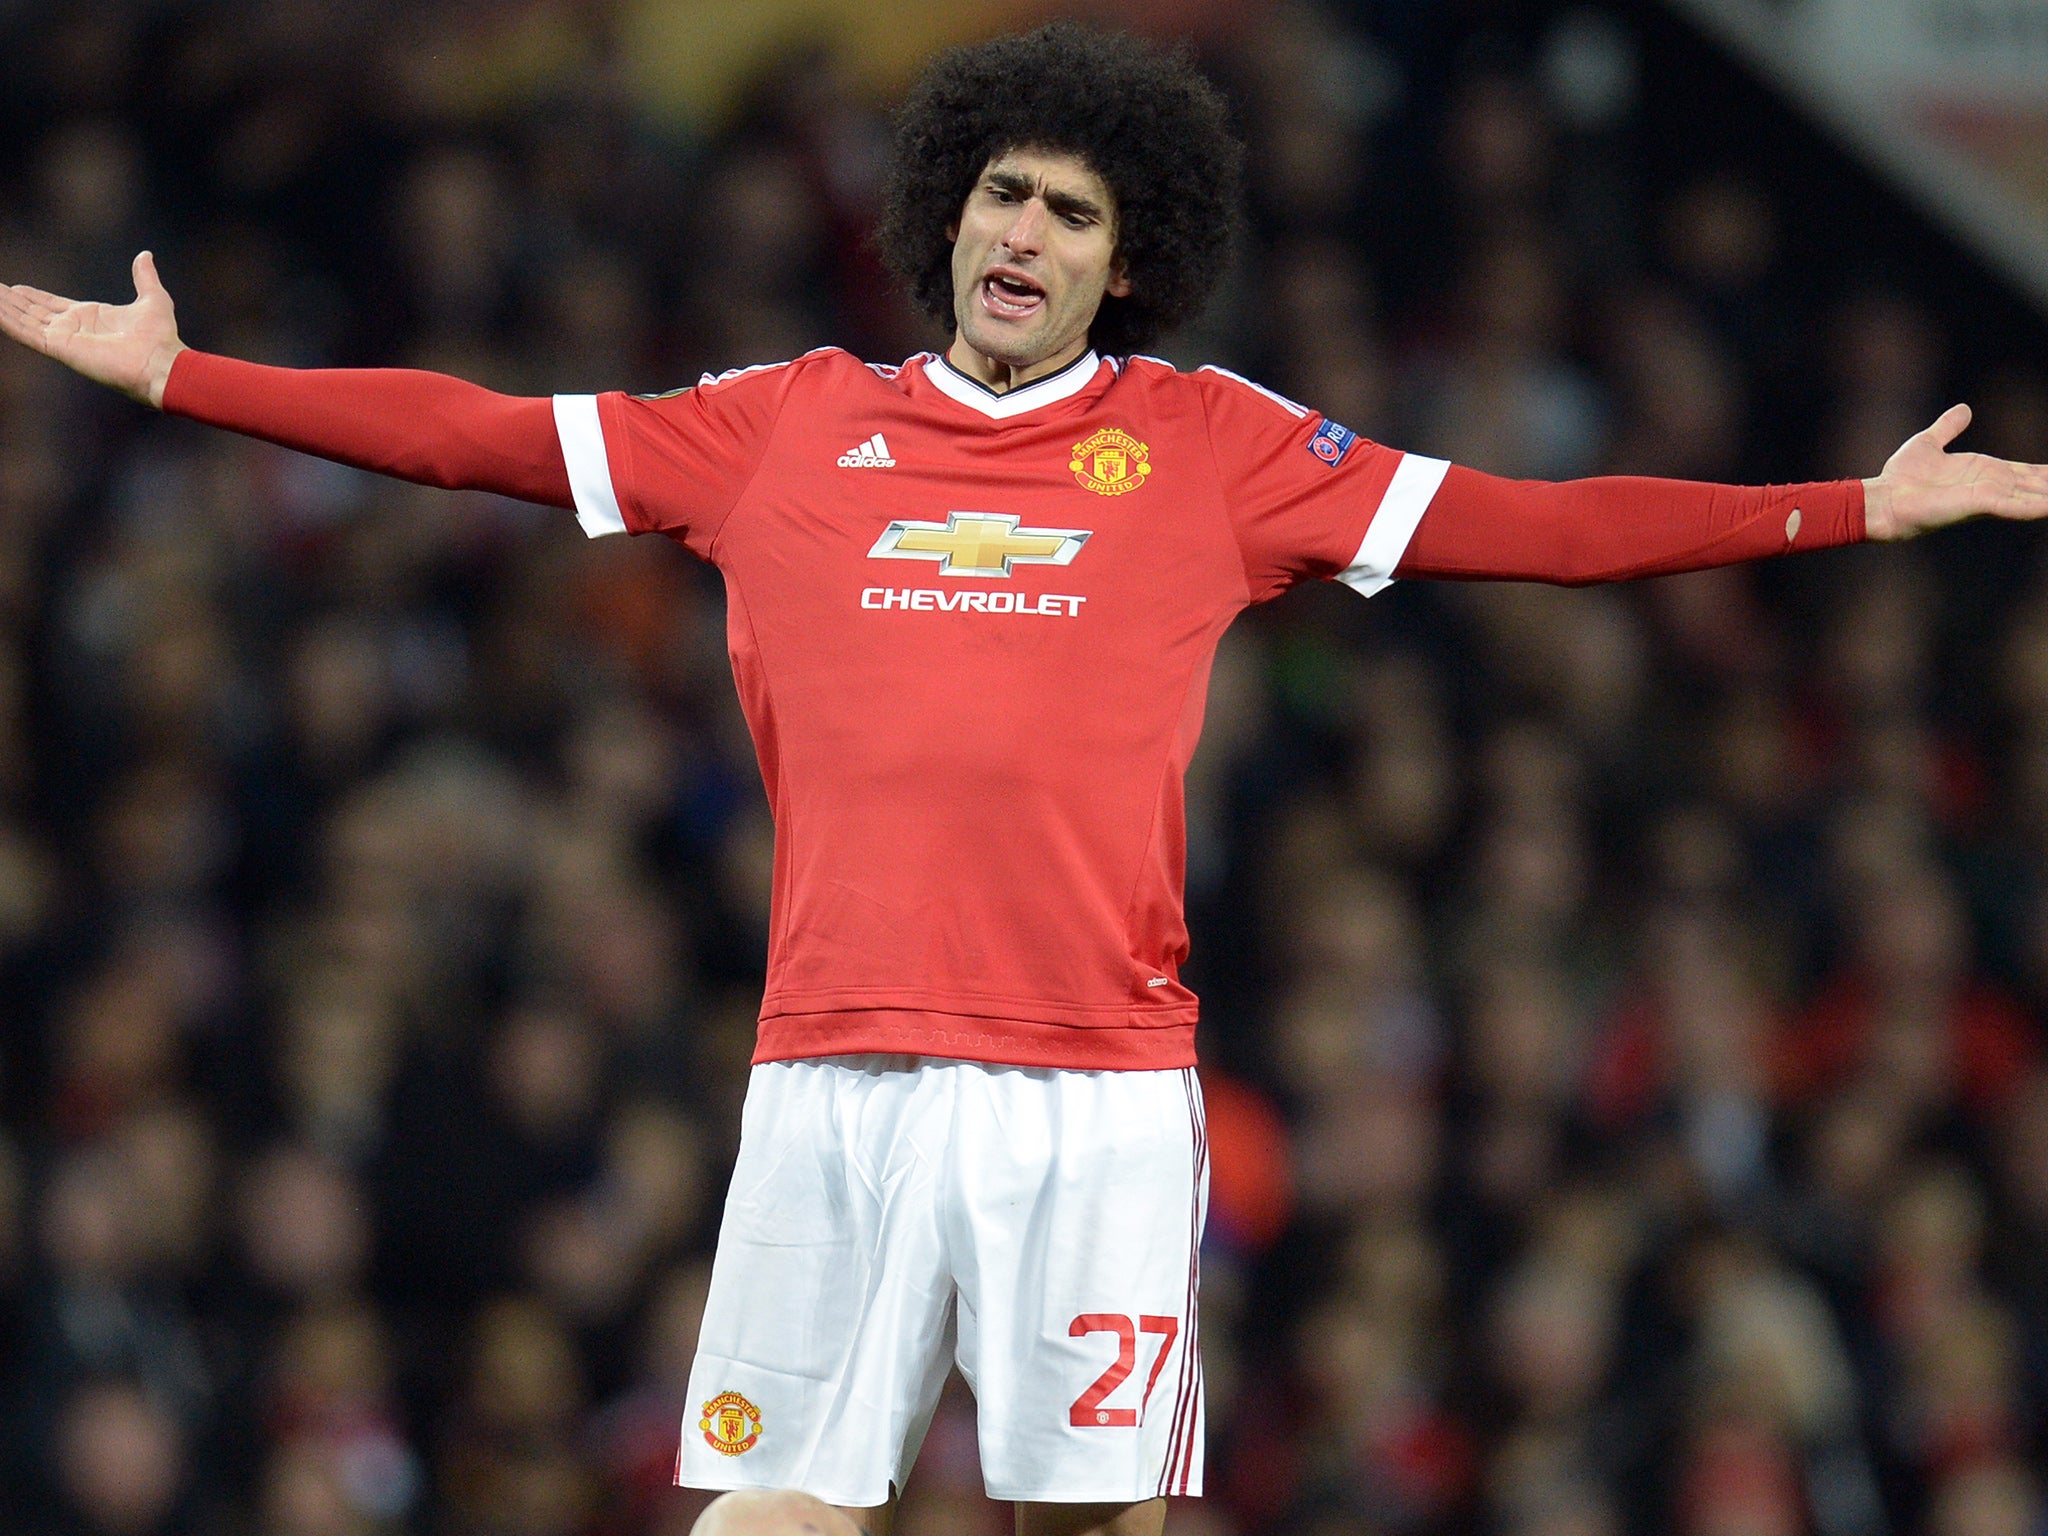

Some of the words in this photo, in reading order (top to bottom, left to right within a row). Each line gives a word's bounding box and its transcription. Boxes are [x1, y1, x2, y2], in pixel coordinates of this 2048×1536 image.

[1078, 434, 1142, 459] MANCHESTER
[837, 454, 896, 468] adidas
[1087, 481, 1133, 492] UNITED
[861, 588, 1087, 617] CHEVROLET
[1069, 1313, 1178, 1428] 27
[706, 1395, 757, 1419] MANCHESTER
[713, 1440, 749, 1452] UNITED
